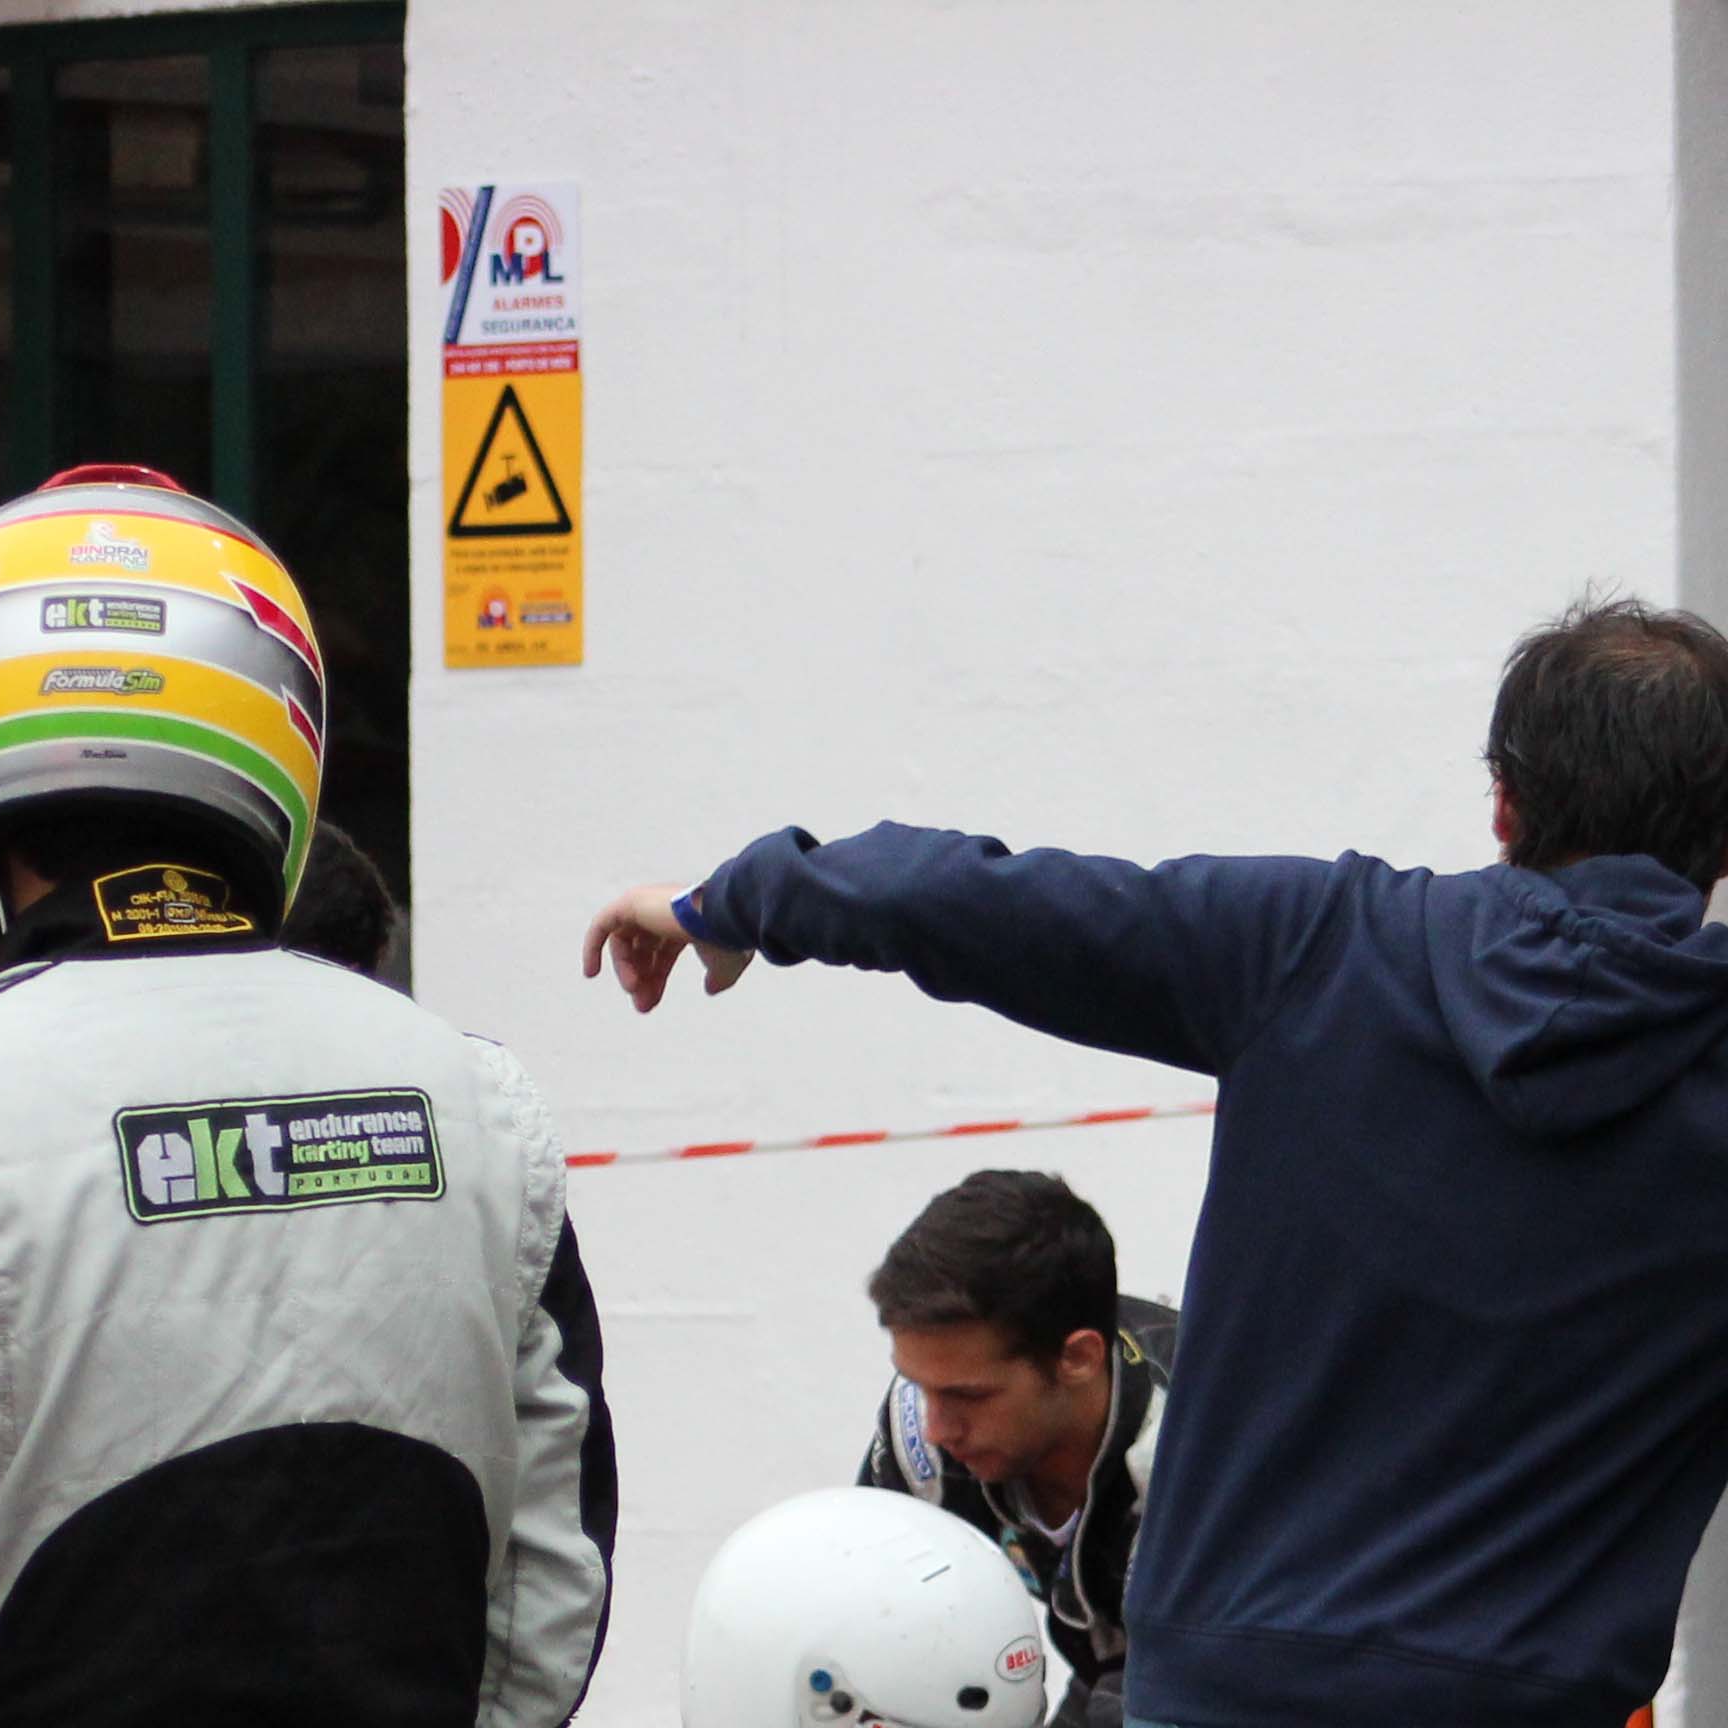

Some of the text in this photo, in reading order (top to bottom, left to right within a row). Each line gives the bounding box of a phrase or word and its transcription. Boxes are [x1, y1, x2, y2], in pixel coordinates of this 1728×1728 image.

[45, 599, 103, 628] ekt
[288, 1110, 425, 1142] endurance
[136, 1112, 289, 1206] ekt
[292, 1134, 426, 1166] karting team
[1005, 1648, 1038, 1671] BELL
